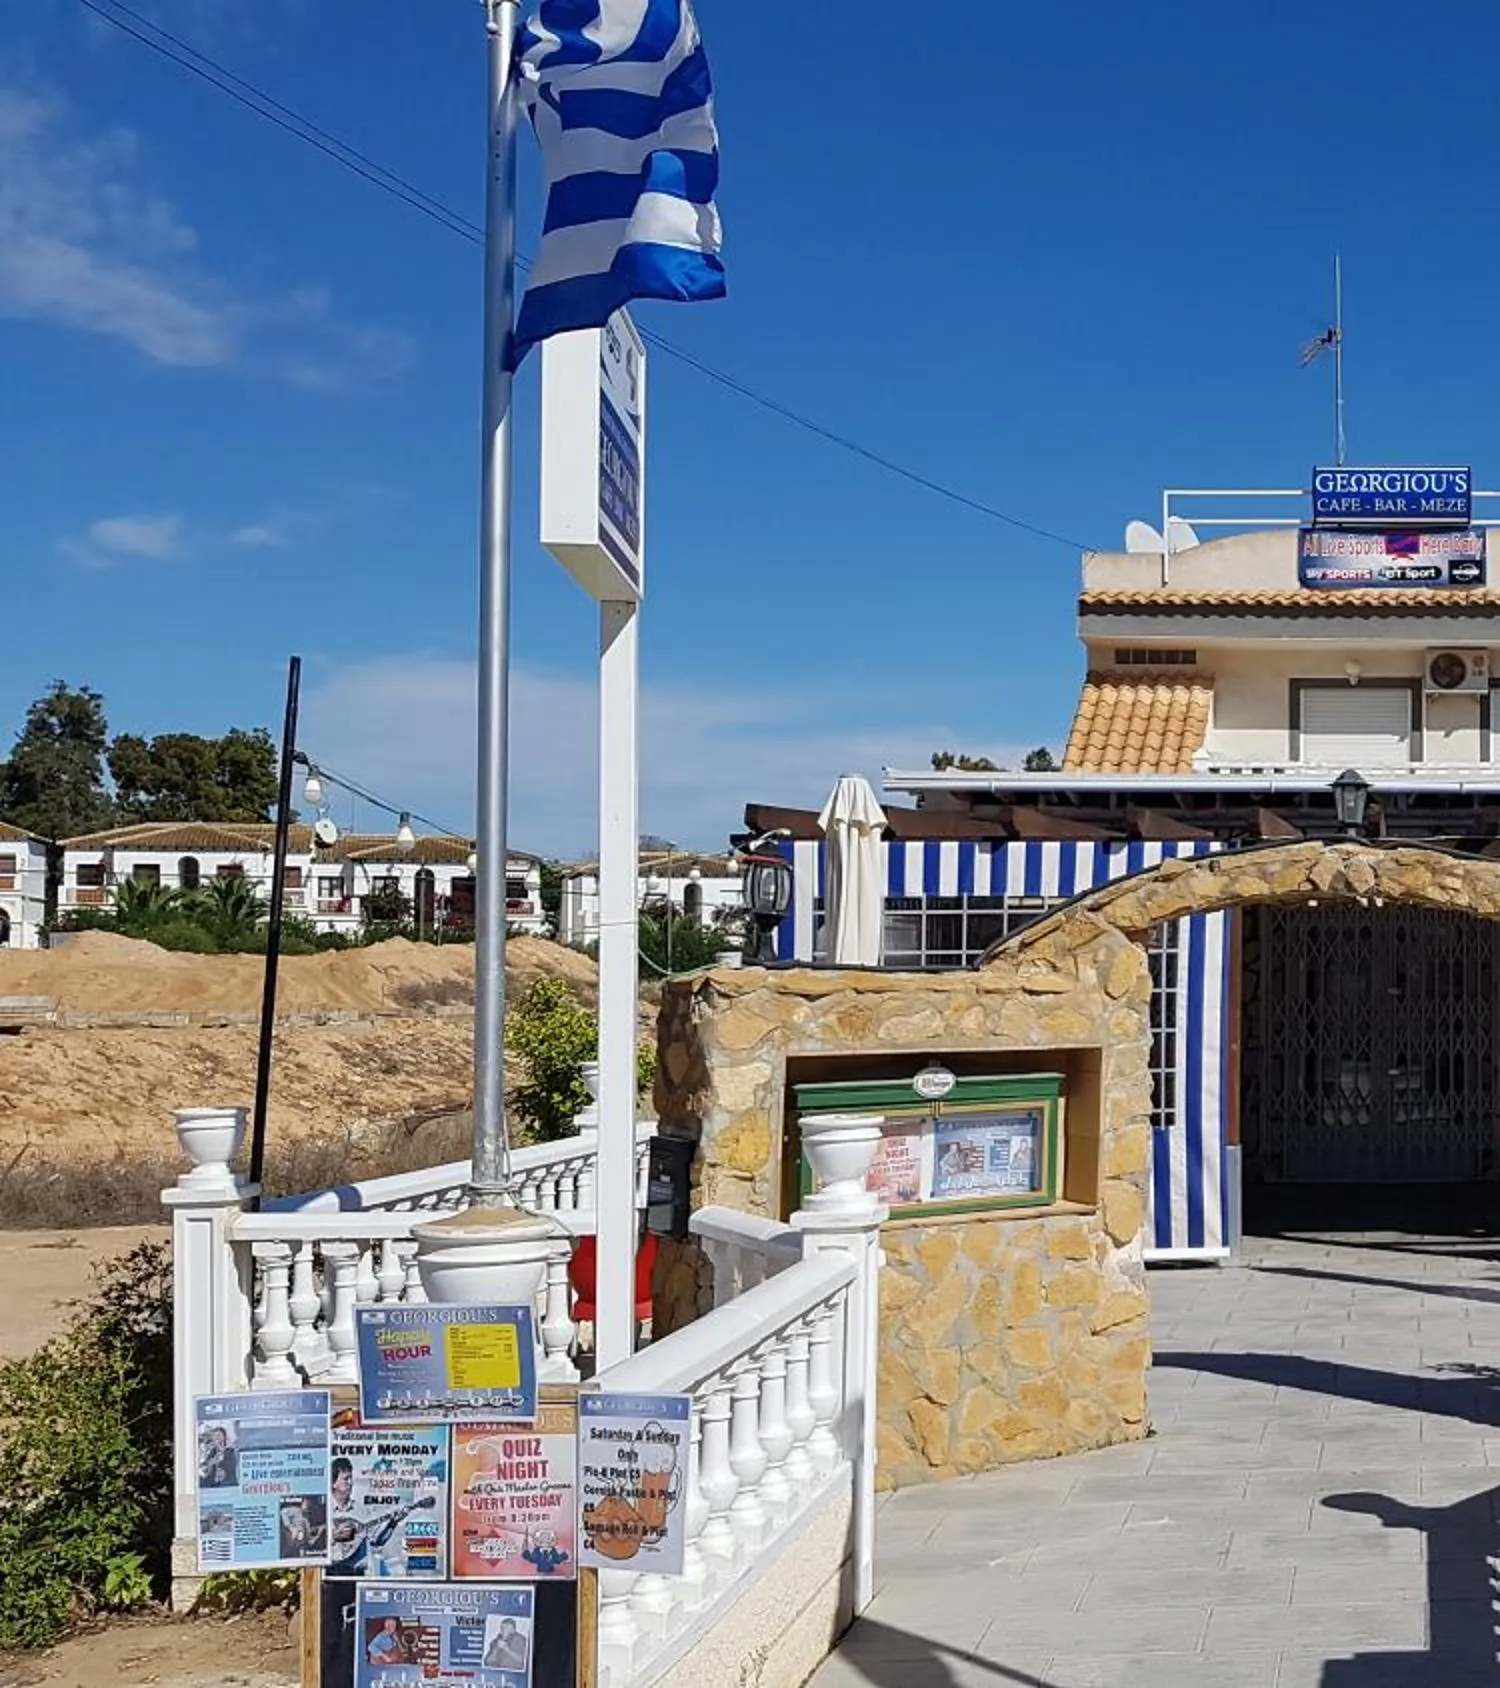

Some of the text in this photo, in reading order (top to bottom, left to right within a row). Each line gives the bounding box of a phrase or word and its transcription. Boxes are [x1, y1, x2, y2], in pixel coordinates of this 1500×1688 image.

[1317, 498, 1361, 512] CAFE
[1375, 498, 1407, 512] BAR
[1420, 498, 1467, 512] MEZE
[1326, 569, 1372, 580] SPORTS
[1405, 568, 1436, 581] Sport
[383, 1345, 432, 1361] HOUR
[590, 1427, 633, 1441] Saturday
[331, 1444, 439, 1457] EVERY MONDAY
[503, 1438, 543, 1459] QUIZ
[497, 1460, 549, 1480] NIGHT
[364, 1496, 400, 1505] ENJOY
[469, 1494, 563, 1511] EVERY TUESDAY
